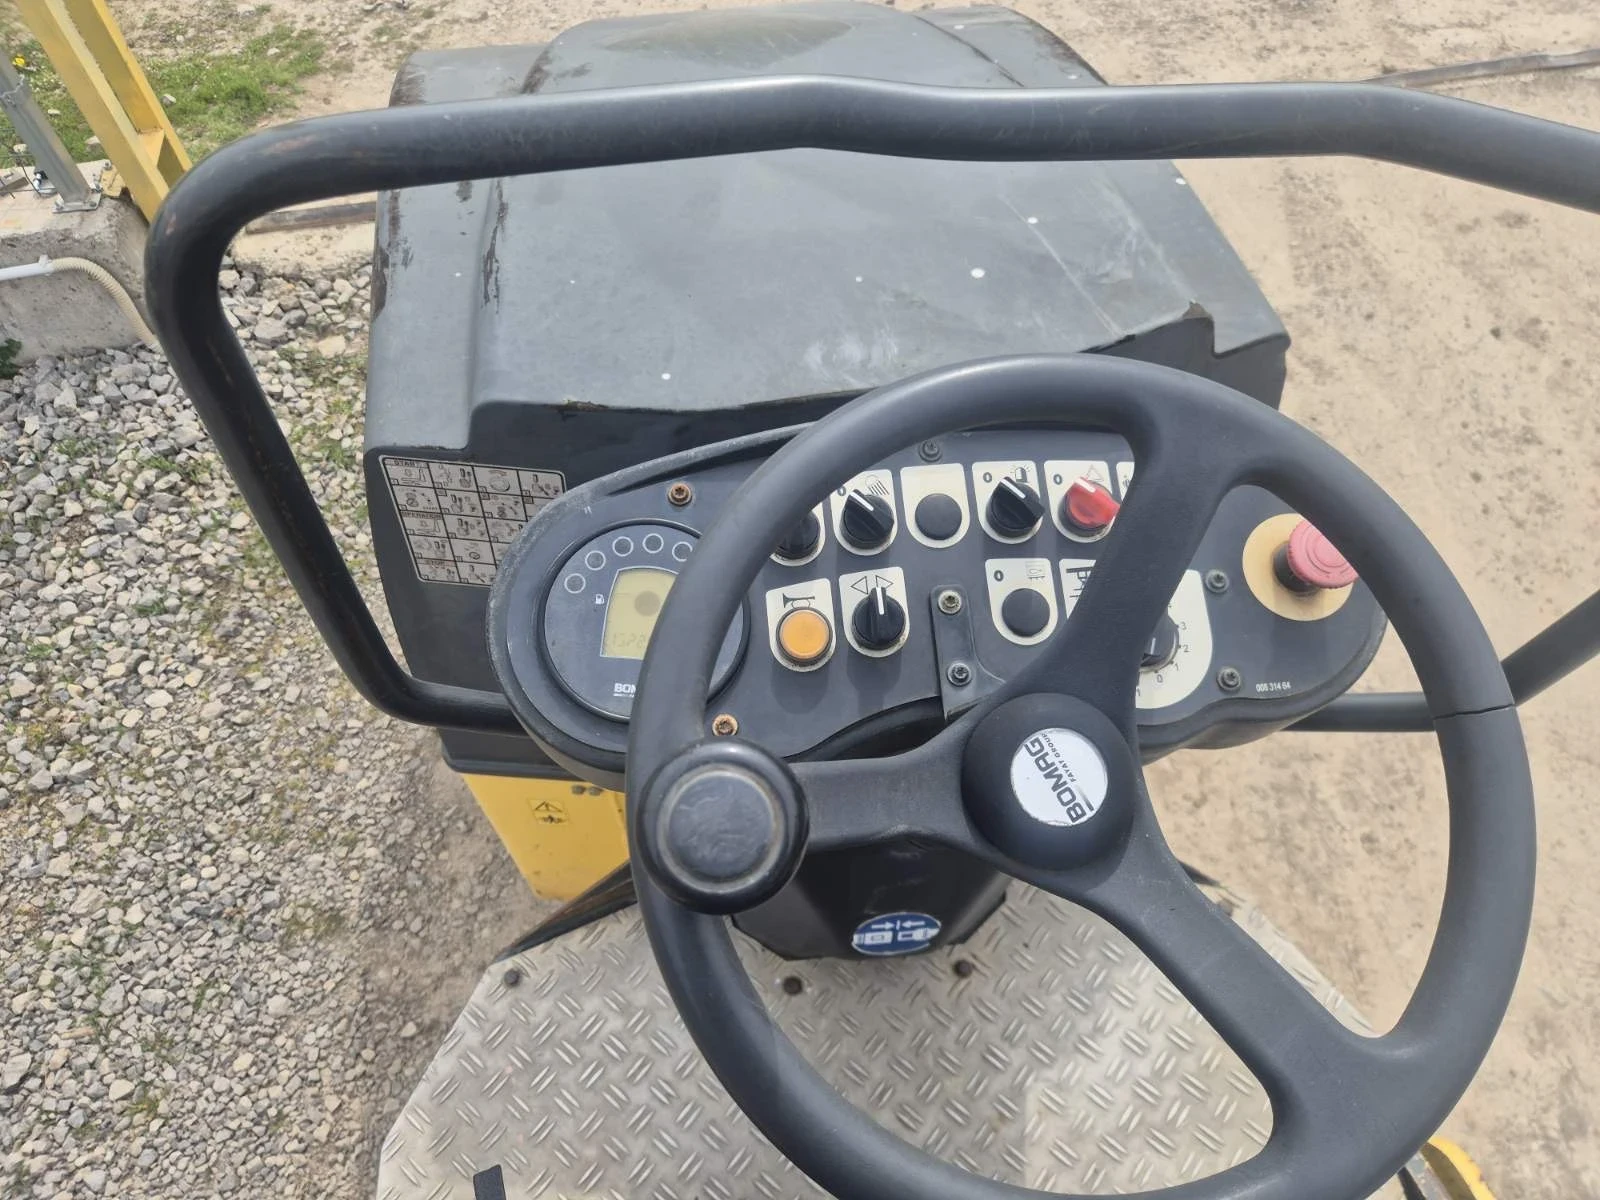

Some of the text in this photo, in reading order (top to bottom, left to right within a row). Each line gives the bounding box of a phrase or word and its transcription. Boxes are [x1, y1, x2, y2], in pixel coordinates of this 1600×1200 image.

[1184, 644, 1191, 653] 2
[1024, 736, 1087, 823] BOMAG
[1058, 759, 1077, 783] FAYAT
